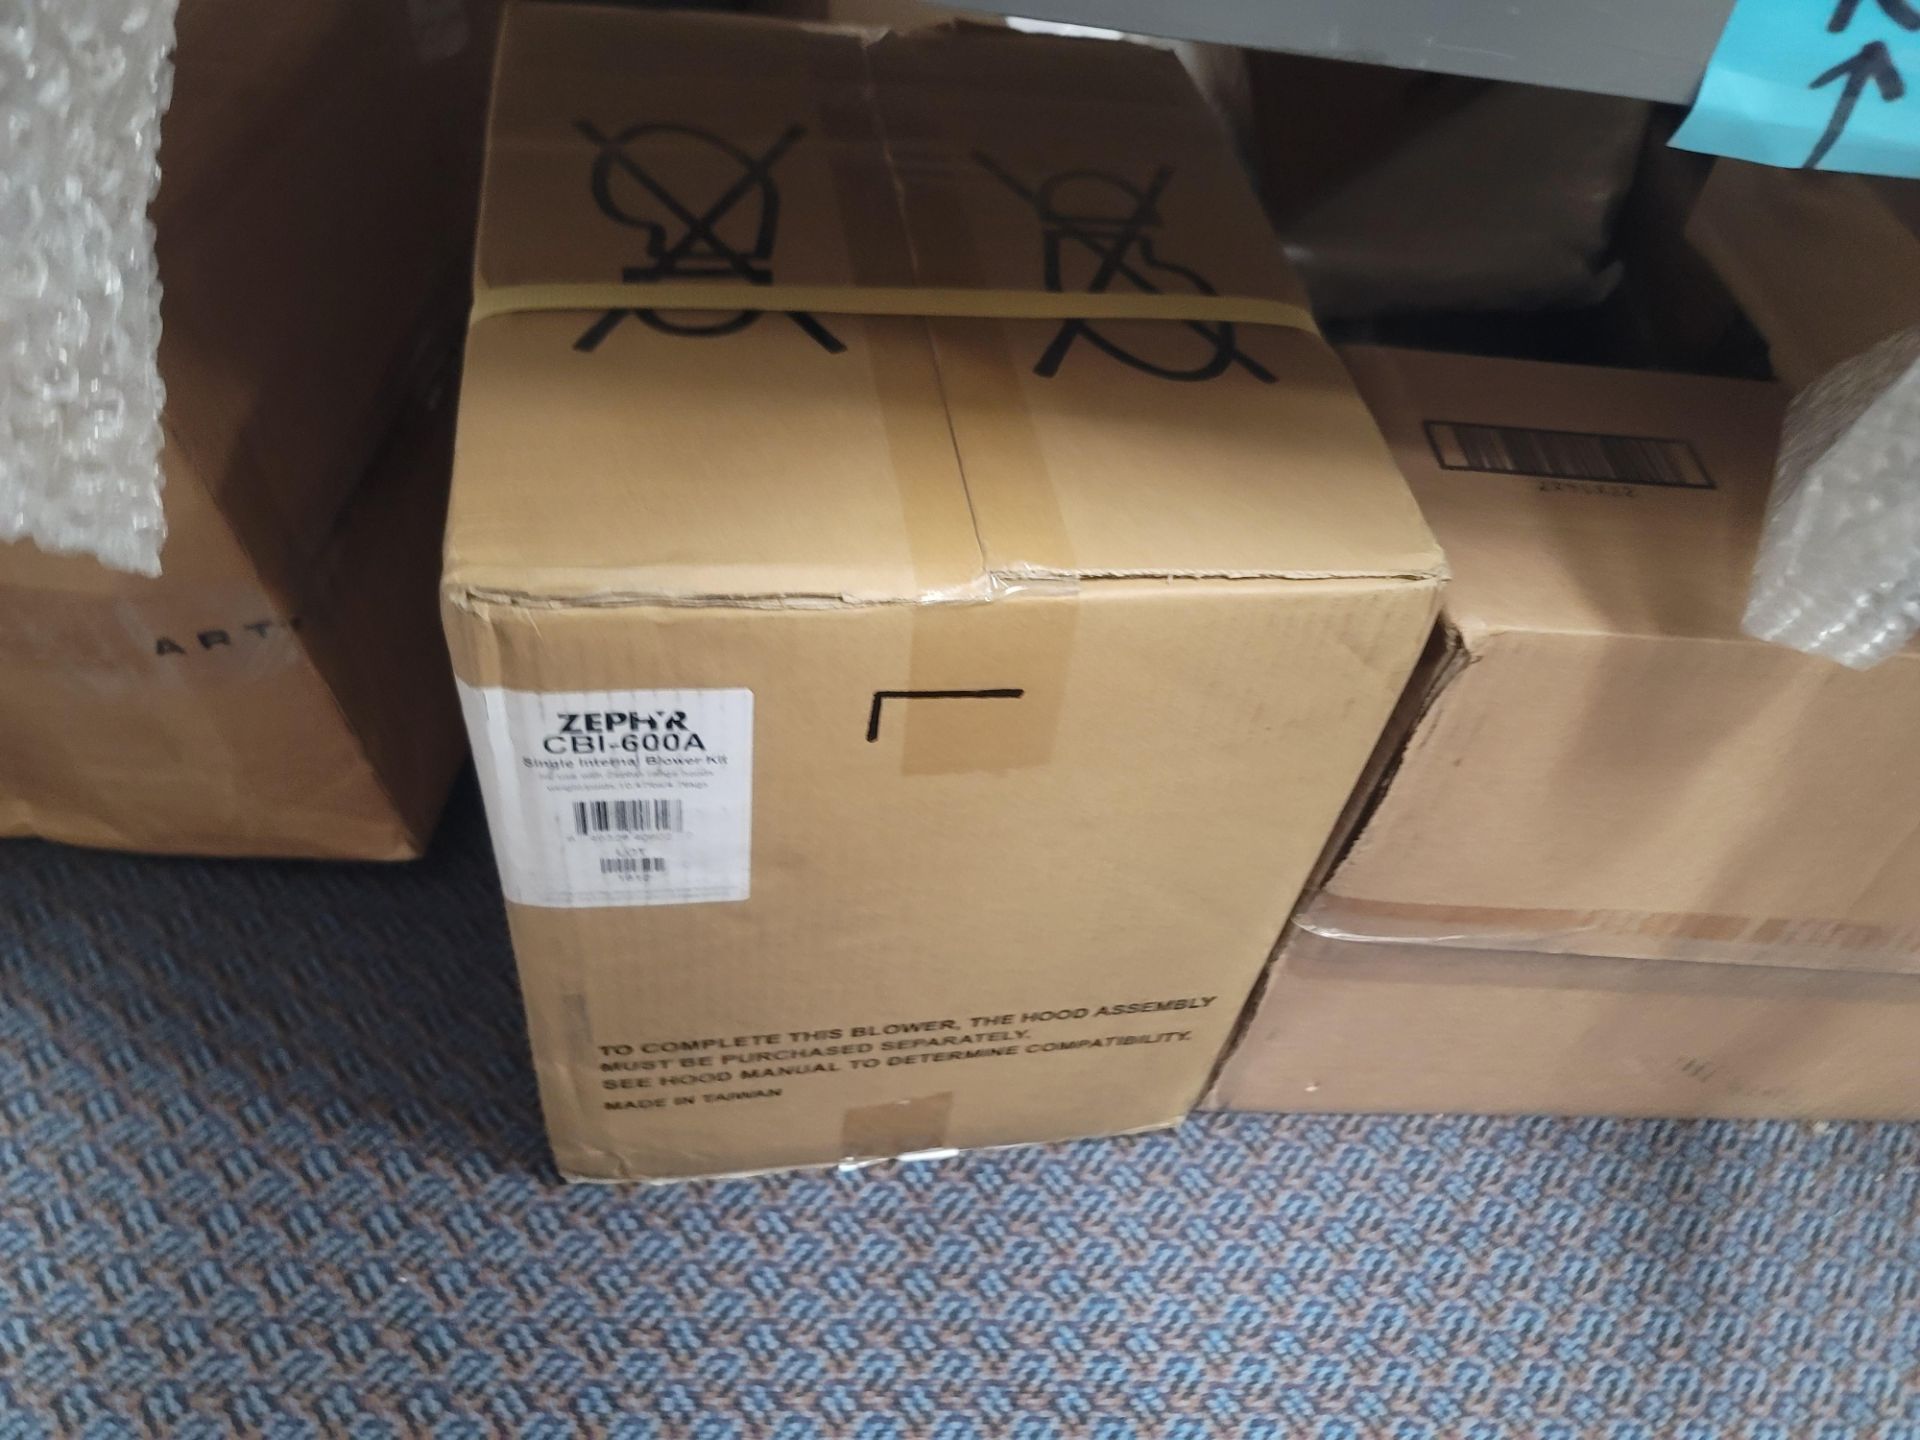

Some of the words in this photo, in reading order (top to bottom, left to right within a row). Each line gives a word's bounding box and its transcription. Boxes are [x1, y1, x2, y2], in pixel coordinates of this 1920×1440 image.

[557, 711, 690, 733] ZEPHYR
[543, 733, 707, 754] CBI-600A
[522, 756, 573, 770] Single
[579, 755, 640, 768] Internal
[645, 754, 701, 767] Blower
[598, 1044, 634, 1056] TO
[640, 1034, 782, 1053] COMPLETE
[787, 1028, 843, 1042] THIS
[848, 1019, 961, 1038] BLOWER,
[969, 1015, 1016, 1029] THE
[1020, 1007, 1090, 1023] HOOD
[1093, 995, 1219, 1018] ASSEMBLY
[600, 1060, 675, 1072] MUST
[678, 1055, 714, 1068] BE
[721, 1043, 874, 1065] PURCHASED
[879, 1029, 1032, 1052] SEPARATELY.
[602, 1078, 653, 1090] SEE
[658, 1071, 733, 1086] HOOD
[740, 1063, 842, 1080] MANUAL
[848, 1058, 881, 1070] TO
[886, 1046, 1019, 1067] DETERMINE
[1024, 1031, 1193, 1054] COMPATIBILITY.
[604, 1098, 668, 1111] MADE
[673, 1096, 696, 1106] IN
[701, 1088, 783, 1104] TAIWAN
